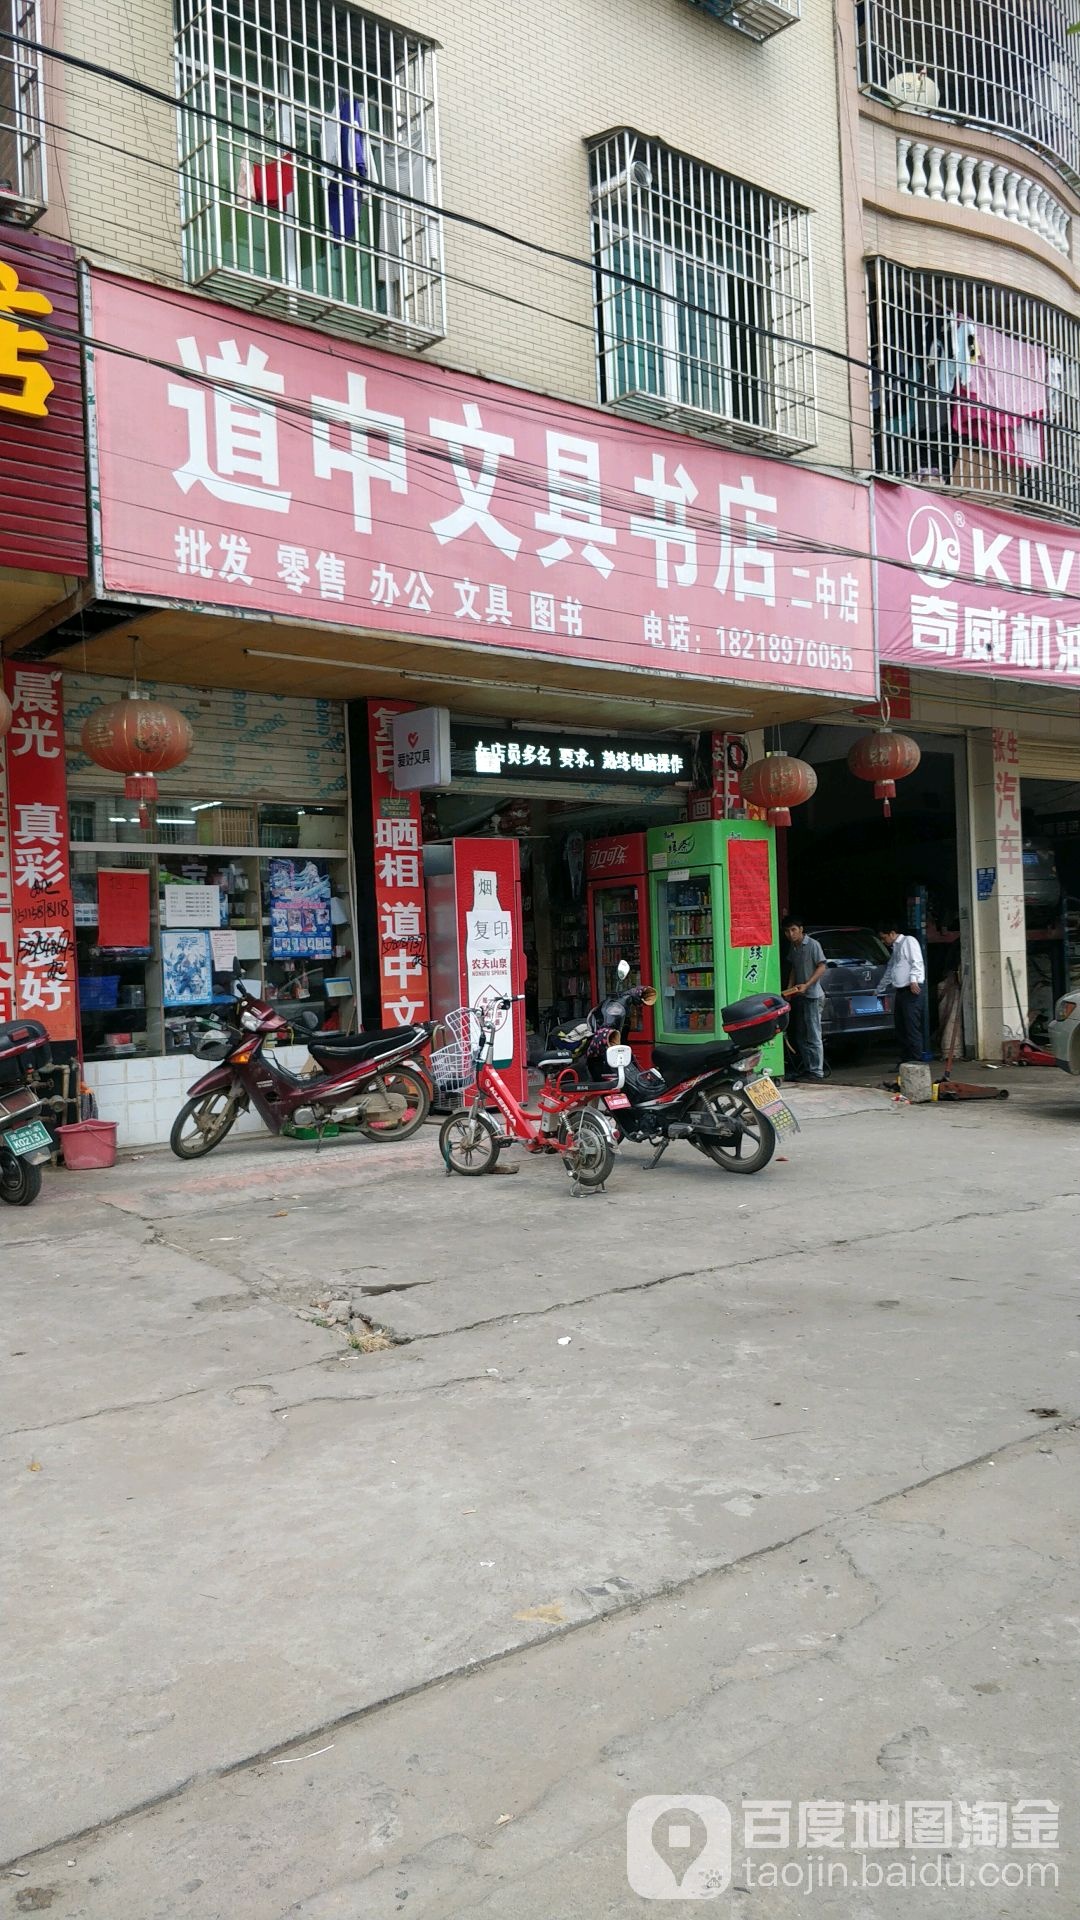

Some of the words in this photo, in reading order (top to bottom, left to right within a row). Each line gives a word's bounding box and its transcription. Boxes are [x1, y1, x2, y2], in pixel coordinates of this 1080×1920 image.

[168, 336, 778, 607] 道中文具书店
[174, 527, 254, 586] 批发
[276, 544, 347, 602] 零售
[369, 564, 435, 614] 办公
[453, 577, 513, 626] 文具
[530, 591, 583, 637] 图书
[790, 567, 859, 625] 二中店
[12, 670, 62, 759] 晨光
[397, 748, 431, 769] 爱好文具
[14, 802, 65, 888] 真彩
[375, 818, 420, 888] 晒相
[996, 772, 1021, 875] 汽车
[478, 878, 493, 896] 烟
[471, 957, 507, 969] 农夫山泉
[474, 920, 510, 941] 复印
